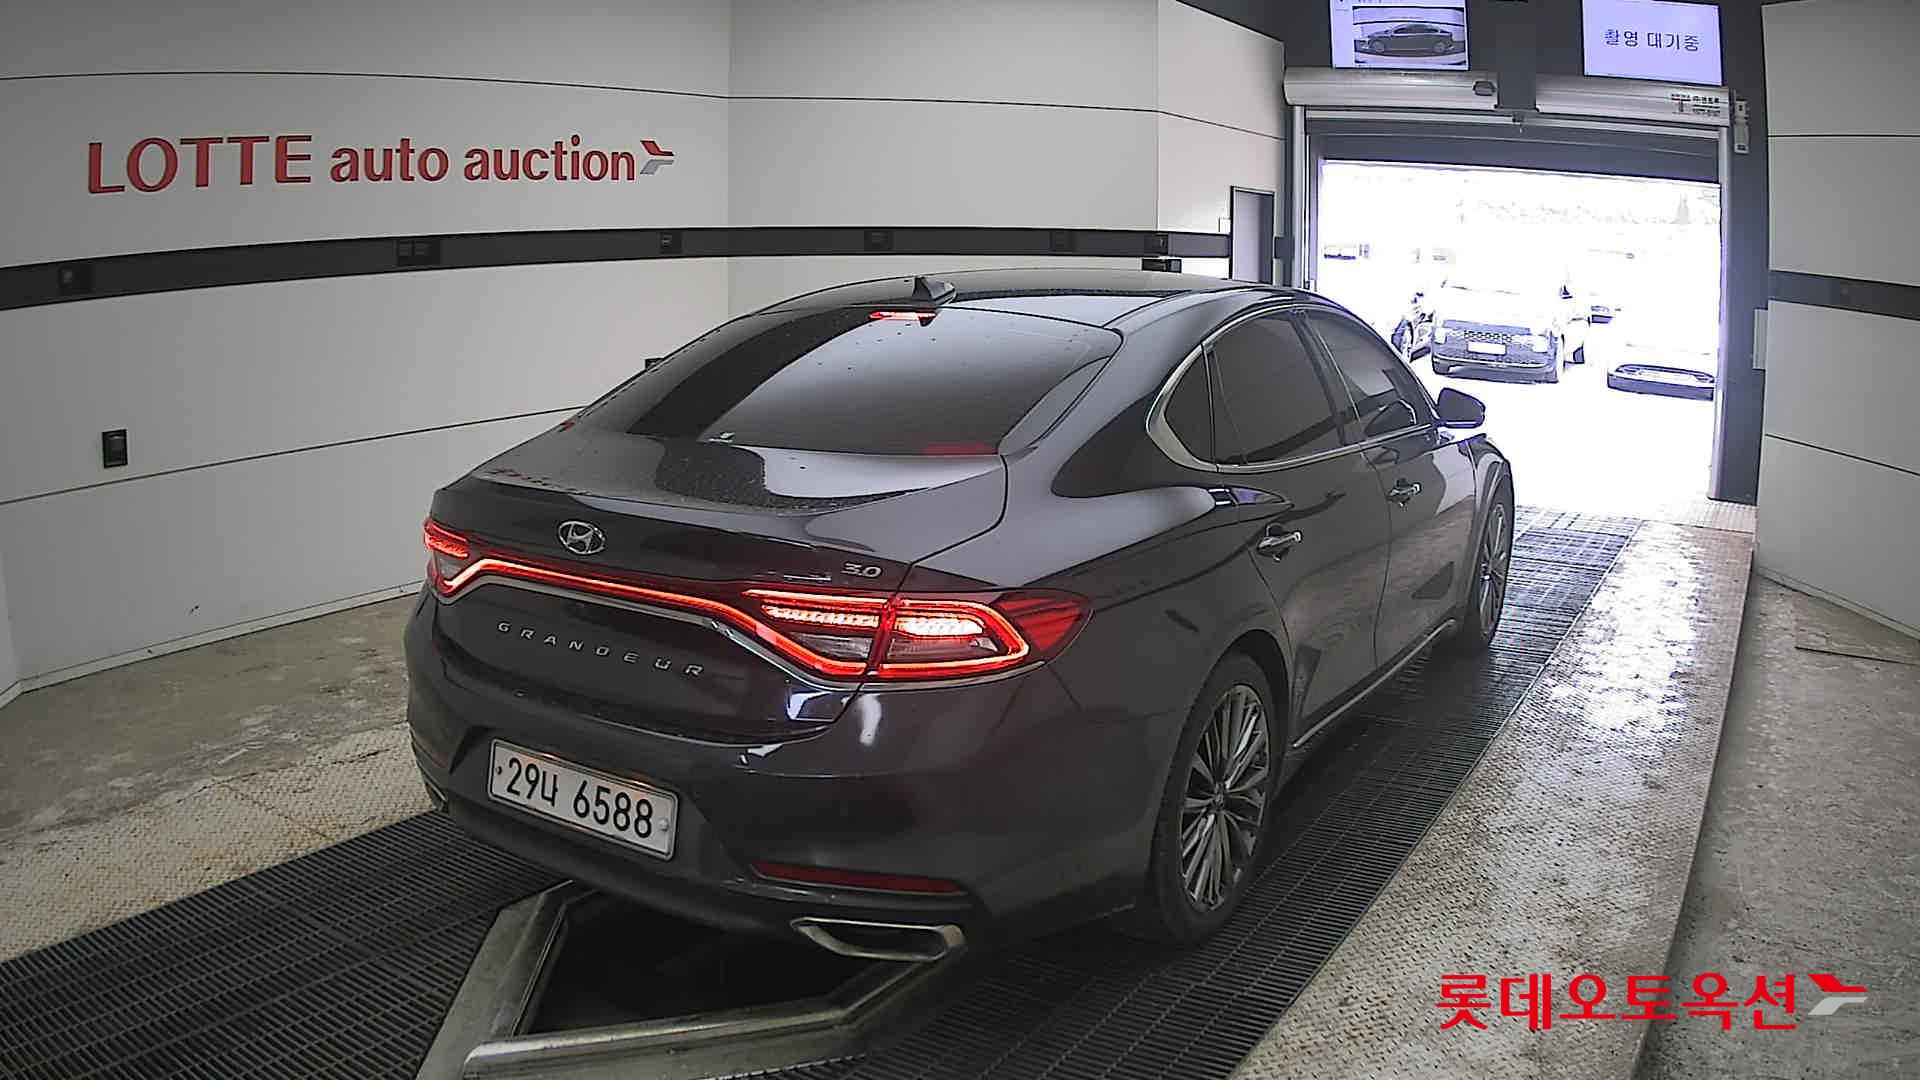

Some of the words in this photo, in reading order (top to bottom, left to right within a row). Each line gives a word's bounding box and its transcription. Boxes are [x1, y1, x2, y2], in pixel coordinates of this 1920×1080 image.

[1604, 28, 1638, 47] 촬영
[1647, 31, 1700, 52] 대기중
[87, 134, 313, 194] LOTTE
[329, 137, 449, 183] auto
[463, 134, 636, 182] auction
[497, 621, 704, 677] GRANDEUR
[506, 757, 559, 807] 29나
[573, 780, 653, 839] 6588
